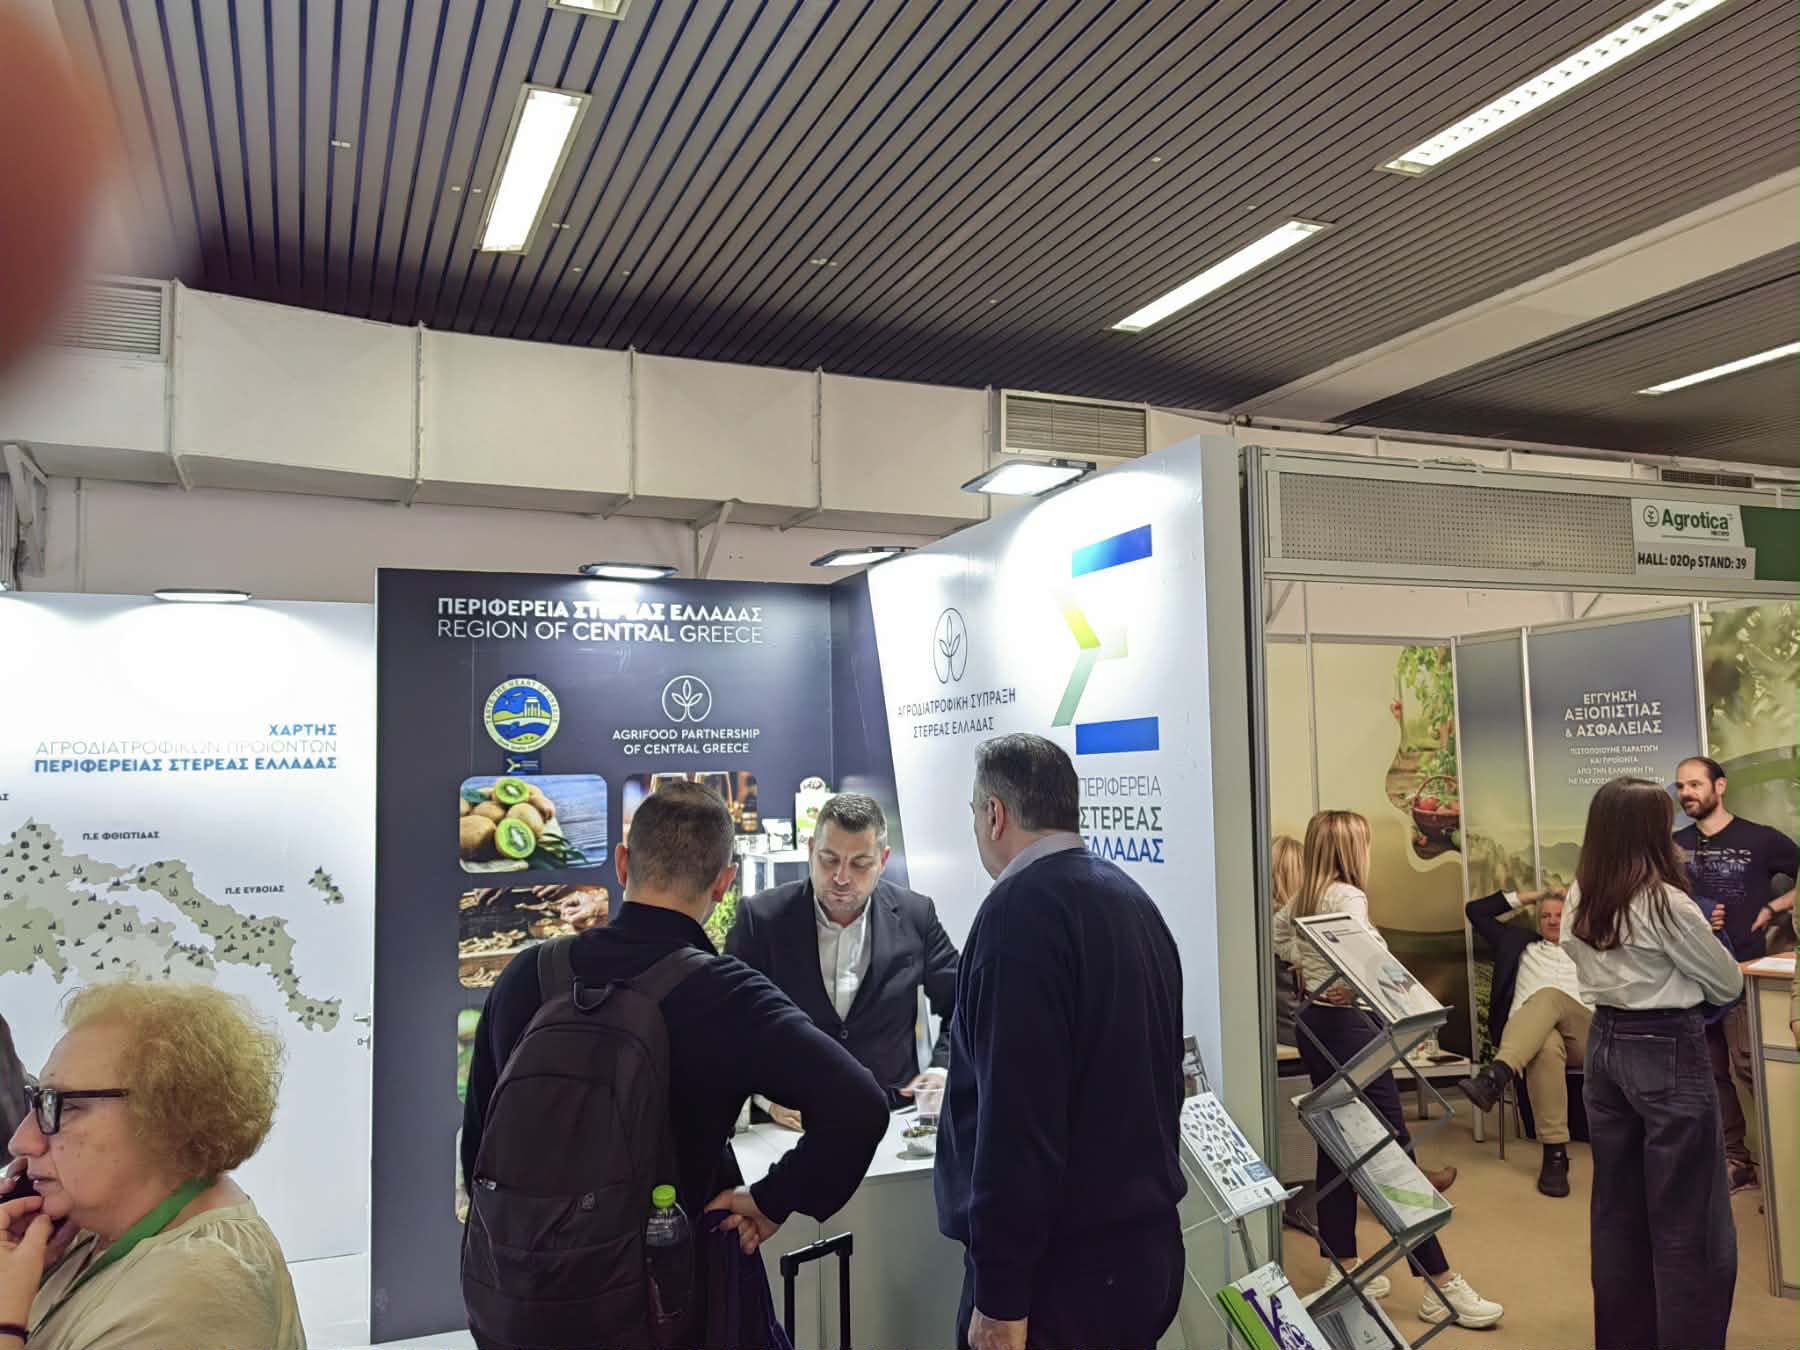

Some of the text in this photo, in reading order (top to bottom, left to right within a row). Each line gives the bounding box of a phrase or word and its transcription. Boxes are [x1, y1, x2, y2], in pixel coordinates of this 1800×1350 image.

[1662, 508, 1729, 531] Agrotica
[1637, 552, 1668, 566] HALL:
[1698, 555, 1734, 569] STAND:
[1735, 558, 1747, 569] 39
[438, 597, 762, 622] ΠΕΡΙΦΕΡΕΙΑ ΣΤΑΣ ΕΛΛΑΔΑΣ
[438, 619, 763, 644] REGION OF CENTRAL GREECE
[971, 688, 1016, 709] ΣΥΠΡΑΞΗ
[1583, 690, 1637, 705] ΕΓΓΥΗΣΗ
[1564, 702, 1661, 721] ΑΞΙΟΠΙΣΤΙΑΣ
[269, 723, 337, 737] ΧΑΡΤΗΣ
[612, 728, 760, 741] AGRIFOOD PARTNERSHIP
[913, 717, 995, 738] ΣΤΕΡΕΑΣ ΕΛΛΑΔΑΣ
[1576, 719, 1663, 737] ΑΣΦΑΛΕΙΑΣ
[623, 742, 750, 755] OF CENTRAL GREECE
[34, 756, 337, 773] ΠΕΡΙΦΕΡΕΙΑΣ ΣΤΕΡΕΑΣ ΕΛΛΑΔΑΣ
[1079, 805, 1163, 832] ΣΤΕΡΕΑΣ
[101, 831, 160, 840] ΦΘΙΩΤΙΔΑΣ
[1081, 835, 1165, 863] ΛΛΑΔΑΣ
